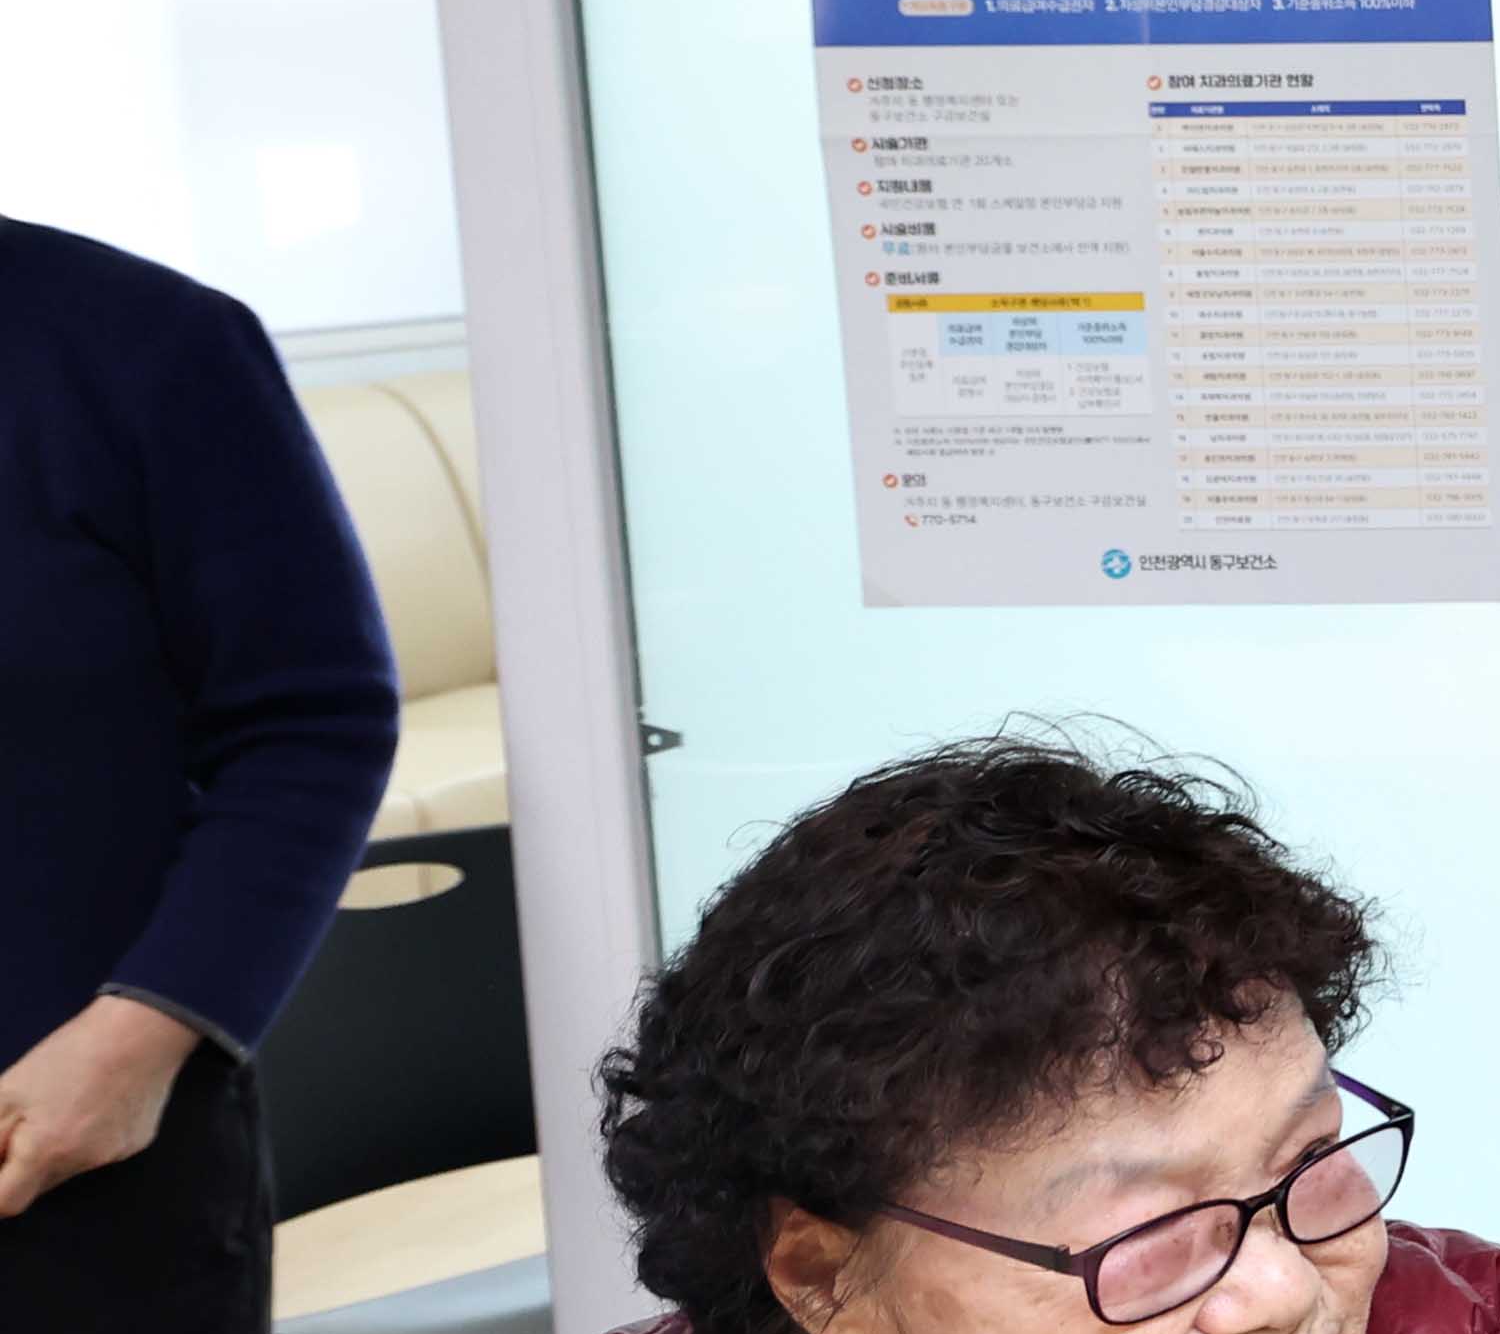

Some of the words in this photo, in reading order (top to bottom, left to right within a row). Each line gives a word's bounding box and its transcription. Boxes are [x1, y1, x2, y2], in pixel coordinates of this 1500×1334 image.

[1199, 74, 1282, 90] 치과의료기관
[1138, 553, 1208, 572] 인천광역시
[1209, 552, 1279, 572] 동구보건소
